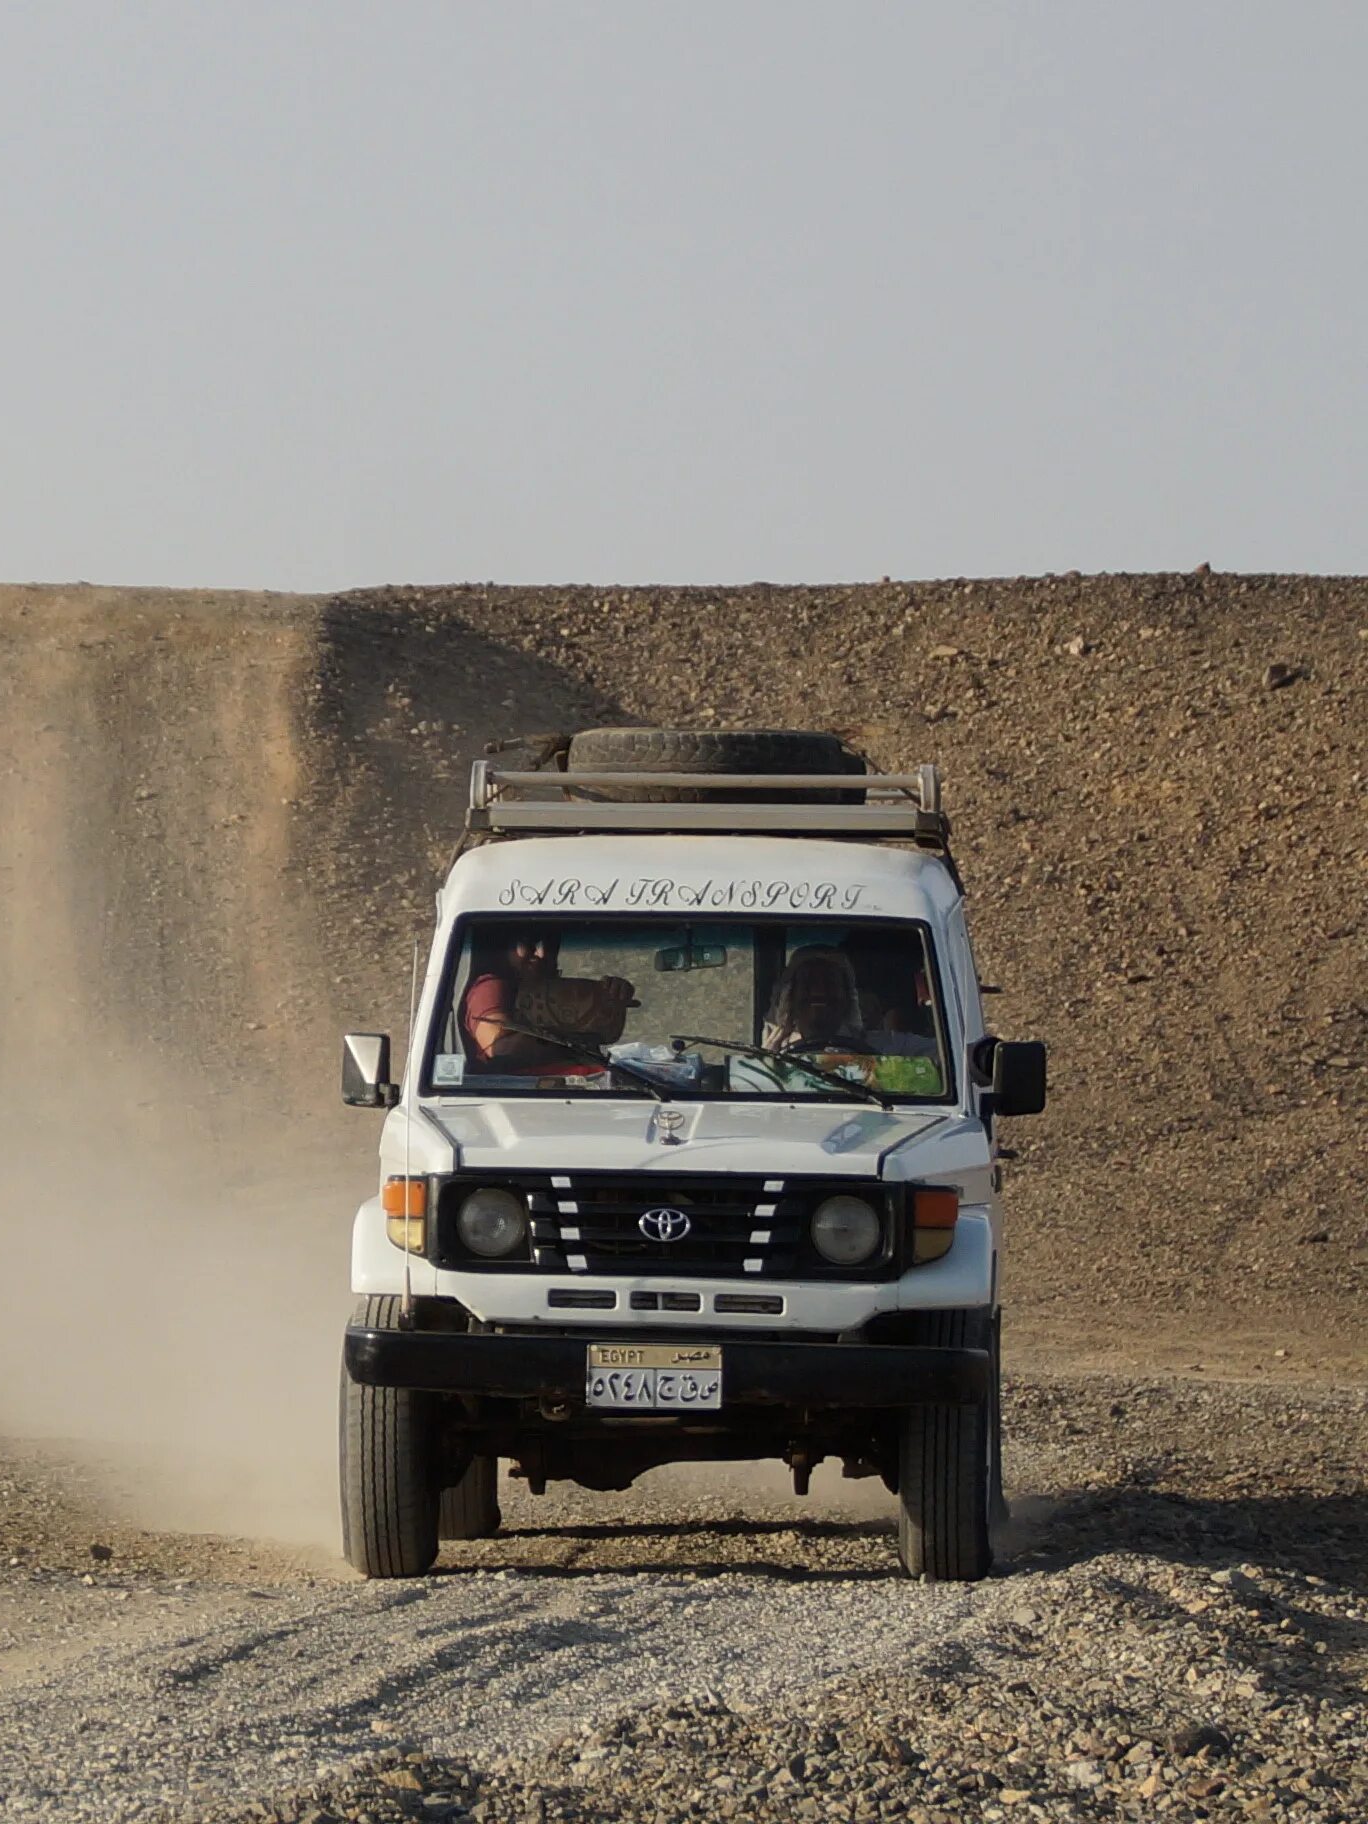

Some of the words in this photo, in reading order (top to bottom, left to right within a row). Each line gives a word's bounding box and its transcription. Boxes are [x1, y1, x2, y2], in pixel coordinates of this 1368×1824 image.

[499, 878, 620, 906] SARA
[625, 878, 869, 910] TRANSPORT
[599, 1349, 645, 1363] EGYPT
[671, 1351, 711, 1364] مصر
[592, 1373, 652, 1401] ٥٢٤٨
